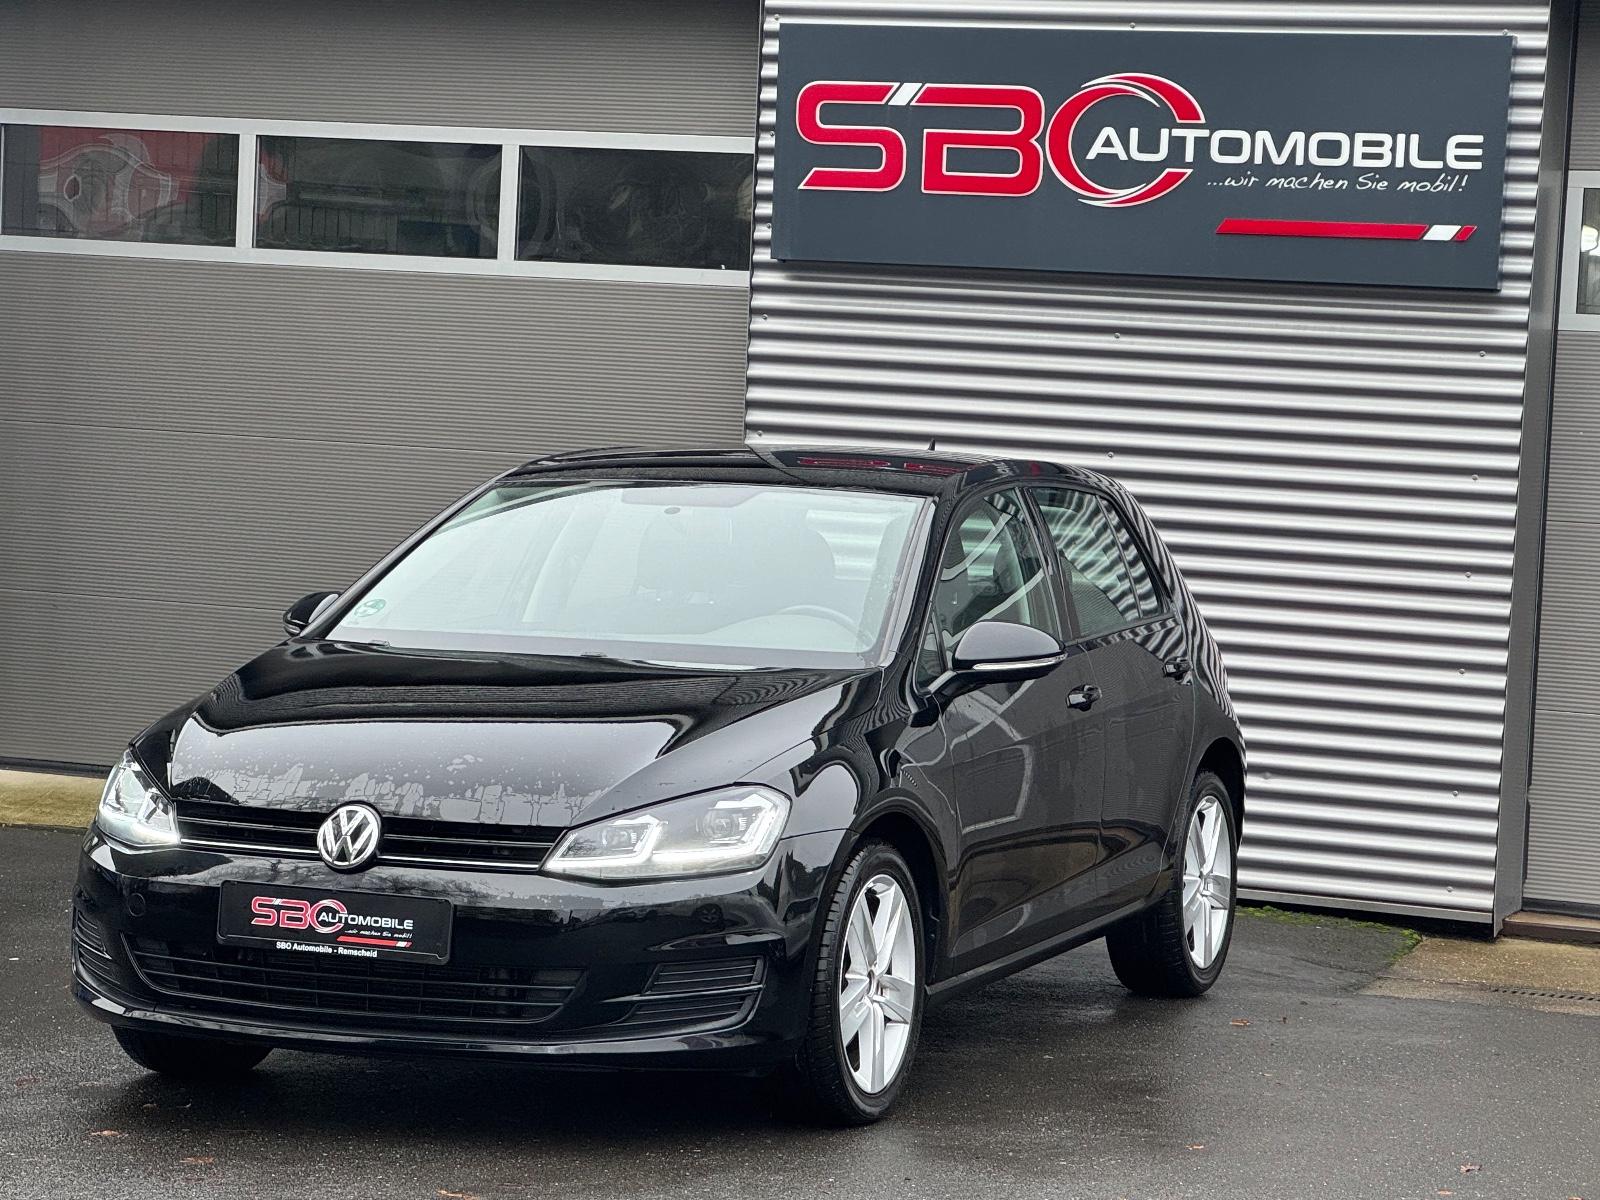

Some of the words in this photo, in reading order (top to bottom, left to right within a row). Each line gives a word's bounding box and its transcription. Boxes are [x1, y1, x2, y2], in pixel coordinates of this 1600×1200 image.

[1087, 126, 1484, 169] AUTOMOBILE
[1265, 172, 1349, 189] machen
[1356, 172, 1389, 190] Sie
[1397, 173, 1469, 192] mobil!
[318, 912, 414, 930] AUTOMOBILE
[276, 941, 292, 950] SBO
[293, 943, 333, 954] Automobile
[338, 947, 378, 958] Remscheid
